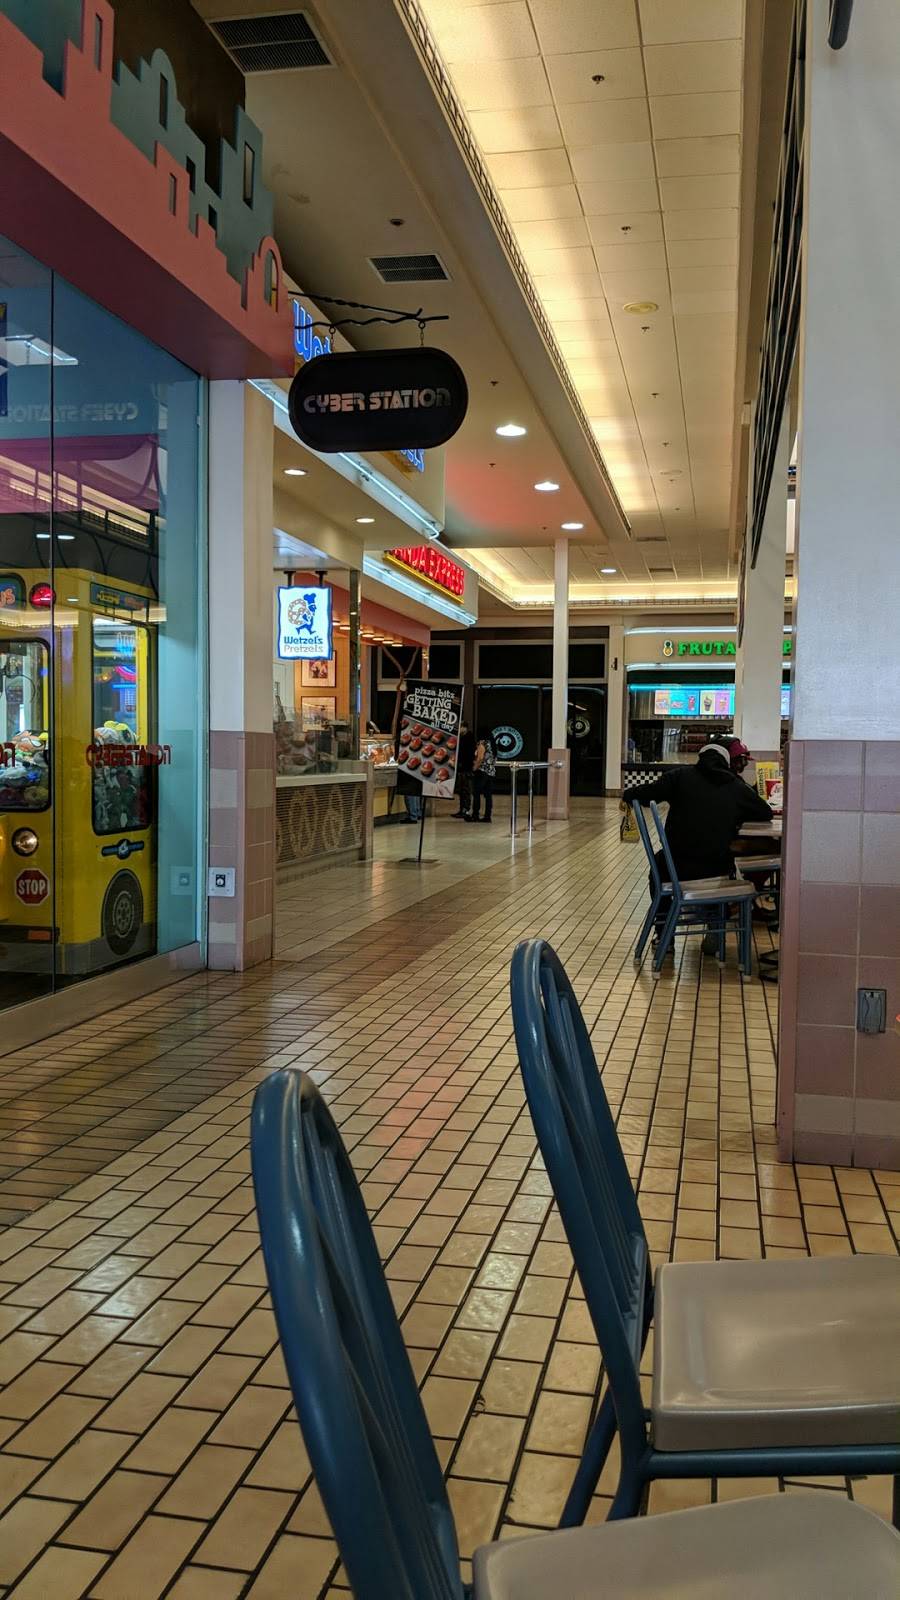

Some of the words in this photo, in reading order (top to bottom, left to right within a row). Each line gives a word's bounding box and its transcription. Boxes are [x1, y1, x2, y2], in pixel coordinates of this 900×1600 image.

[303, 393, 365, 413] CYBER
[369, 388, 450, 410] STATION
[391, 545, 428, 574] NDA
[284, 635, 323, 644] Wetzel's
[284, 644, 323, 653] Pretzels
[414, 687, 436, 697] pizza
[406, 694, 452, 710] GETTING
[411, 704, 458, 725] BAKED
[430, 718, 440, 728] all
[441, 722, 454, 732] day
[18, 879, 46, 895] STOP
